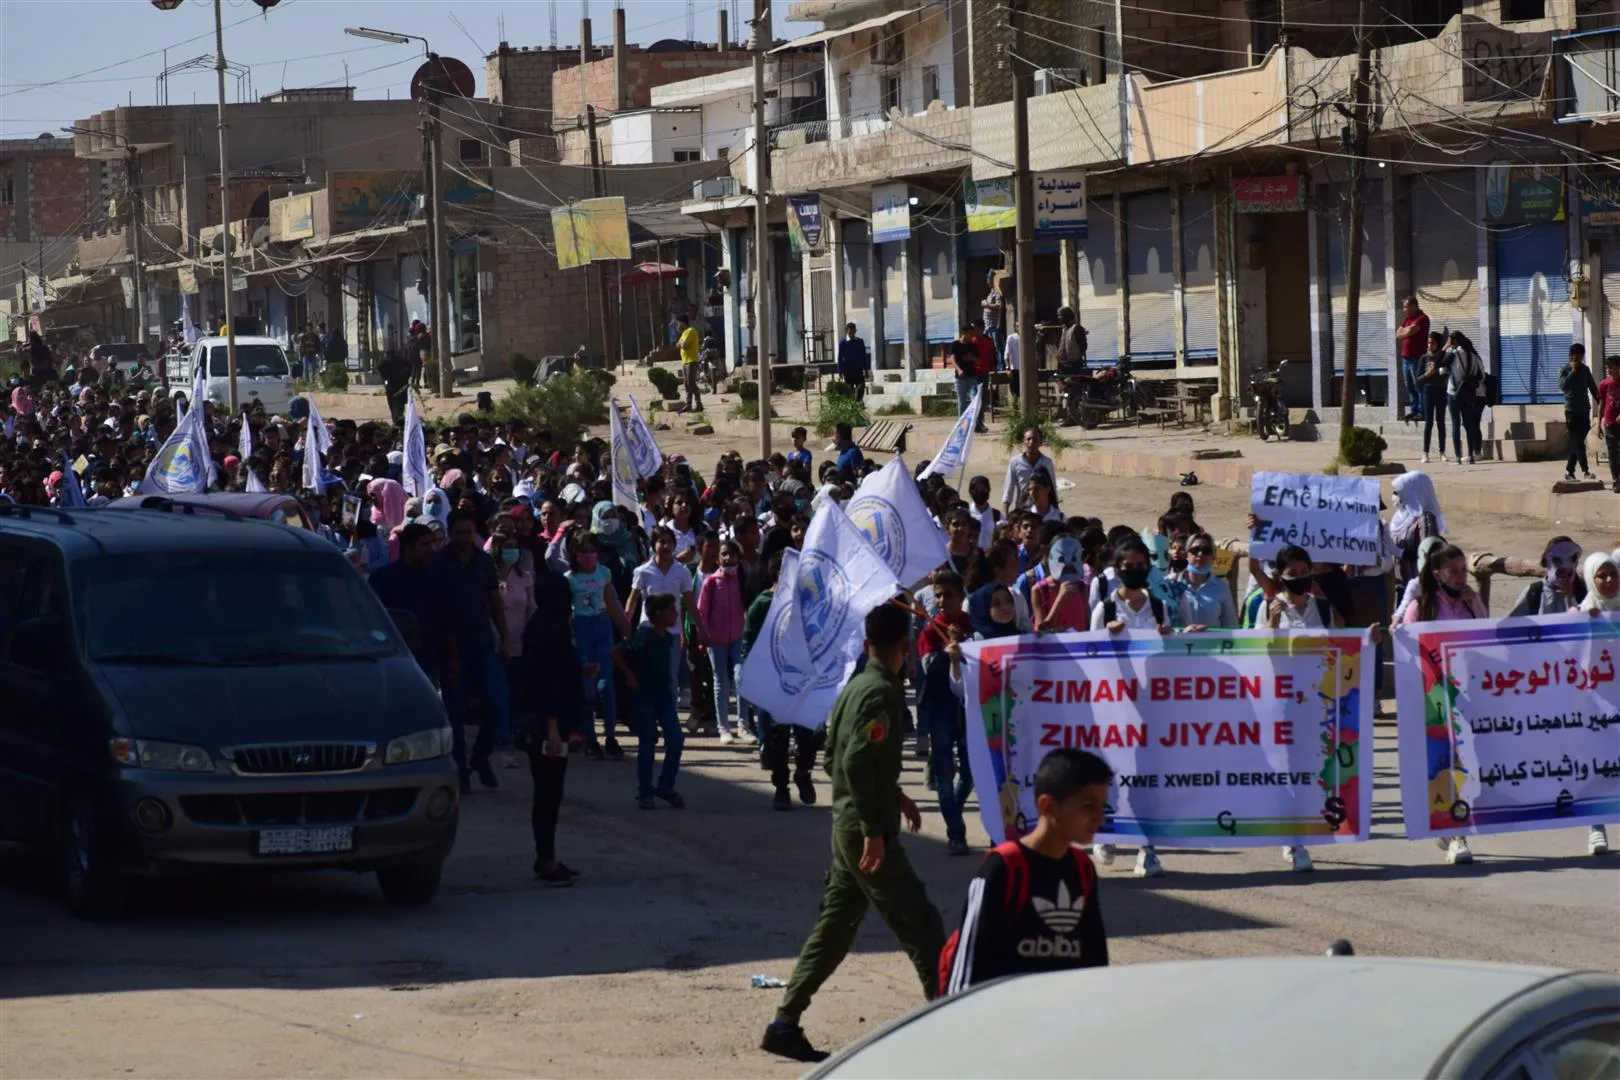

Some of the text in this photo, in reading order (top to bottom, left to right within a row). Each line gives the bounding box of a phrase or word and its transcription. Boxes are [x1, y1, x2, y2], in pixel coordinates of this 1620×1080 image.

[1037, 177, 1082, 194] صيدلية
[1031, 674, 1305, 705] ZIMAN BEDEN E,
[1481, 661, 1560, 697] الوجود
[1040, 721, 1294, 749] ZIMAN JIYAN E
[1120, 774, 1158, 788] XWE
[1164, 770, 1222, 788] XWEDÎ
[1226, 771, 1311, 787] DERKEVE
